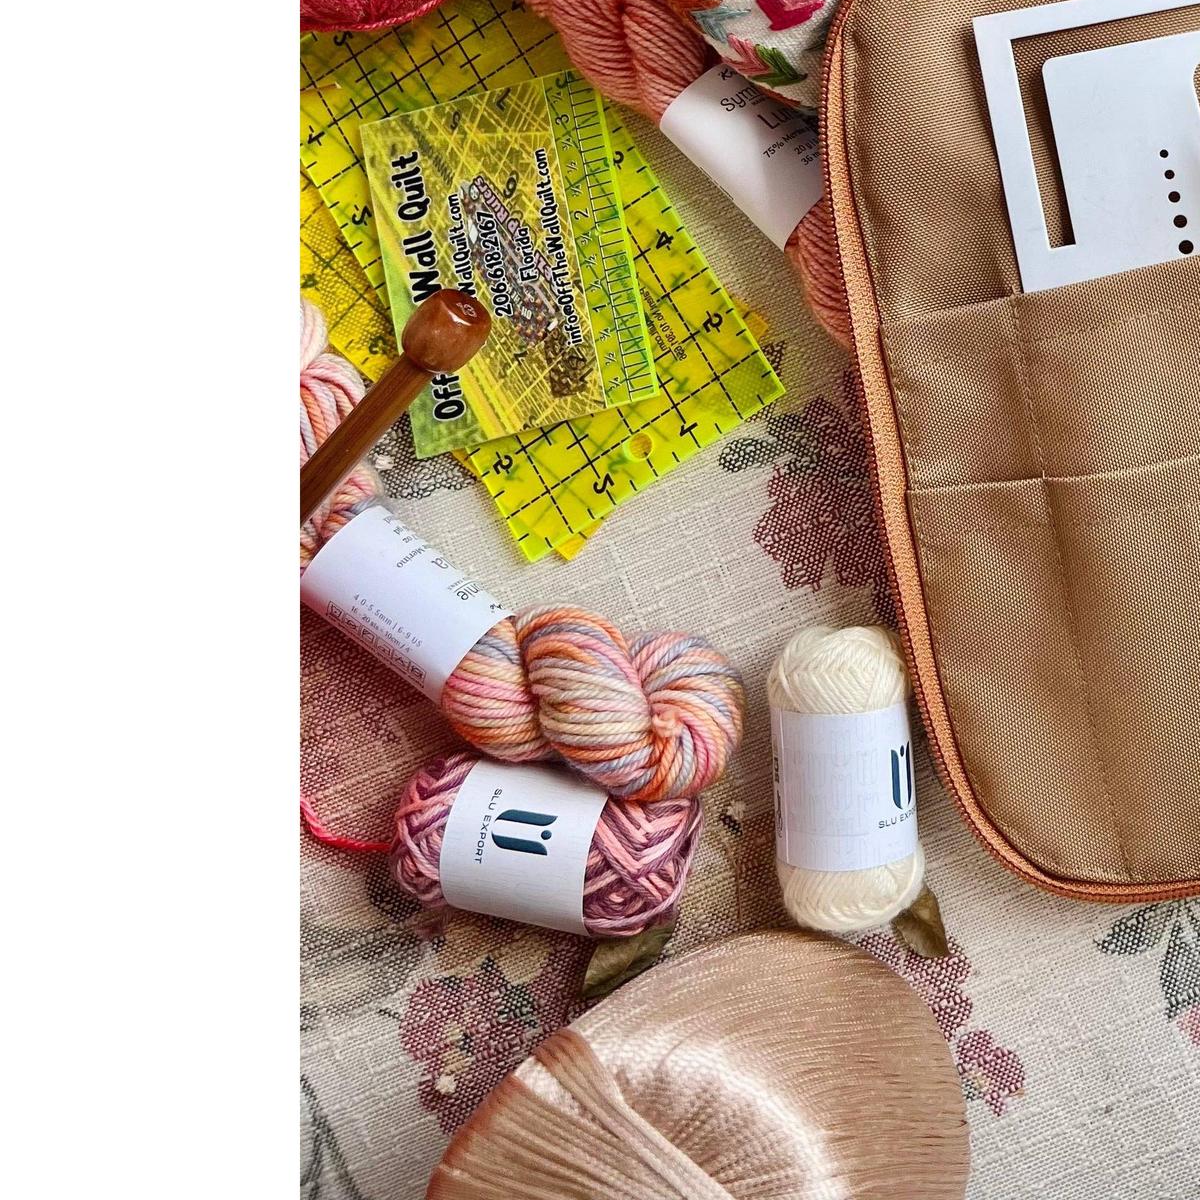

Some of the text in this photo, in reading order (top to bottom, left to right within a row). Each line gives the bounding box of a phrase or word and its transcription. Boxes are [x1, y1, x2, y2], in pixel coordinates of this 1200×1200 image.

[555, 114, 570, 126] 3
[763, 140, 785, 159] 75%
[390, 150, 432, 222] Quilt
[474, 175, 509, 224] Rulers
[574, 208, 590, 221] 2
[402, 229, 442, 303] Wall
[476, 211, 514, 318] 206.618.2167
[515, 227, 538, 282] Florida
[535, 148, 583, 346] info@OffTheWallQuilt.com
[432, 373, 466, 421] Off
[411, 636, 424, 648] US
[473, 788, 503, 865] SLU EXPORT
[878, 817, 897, 829] SLU
